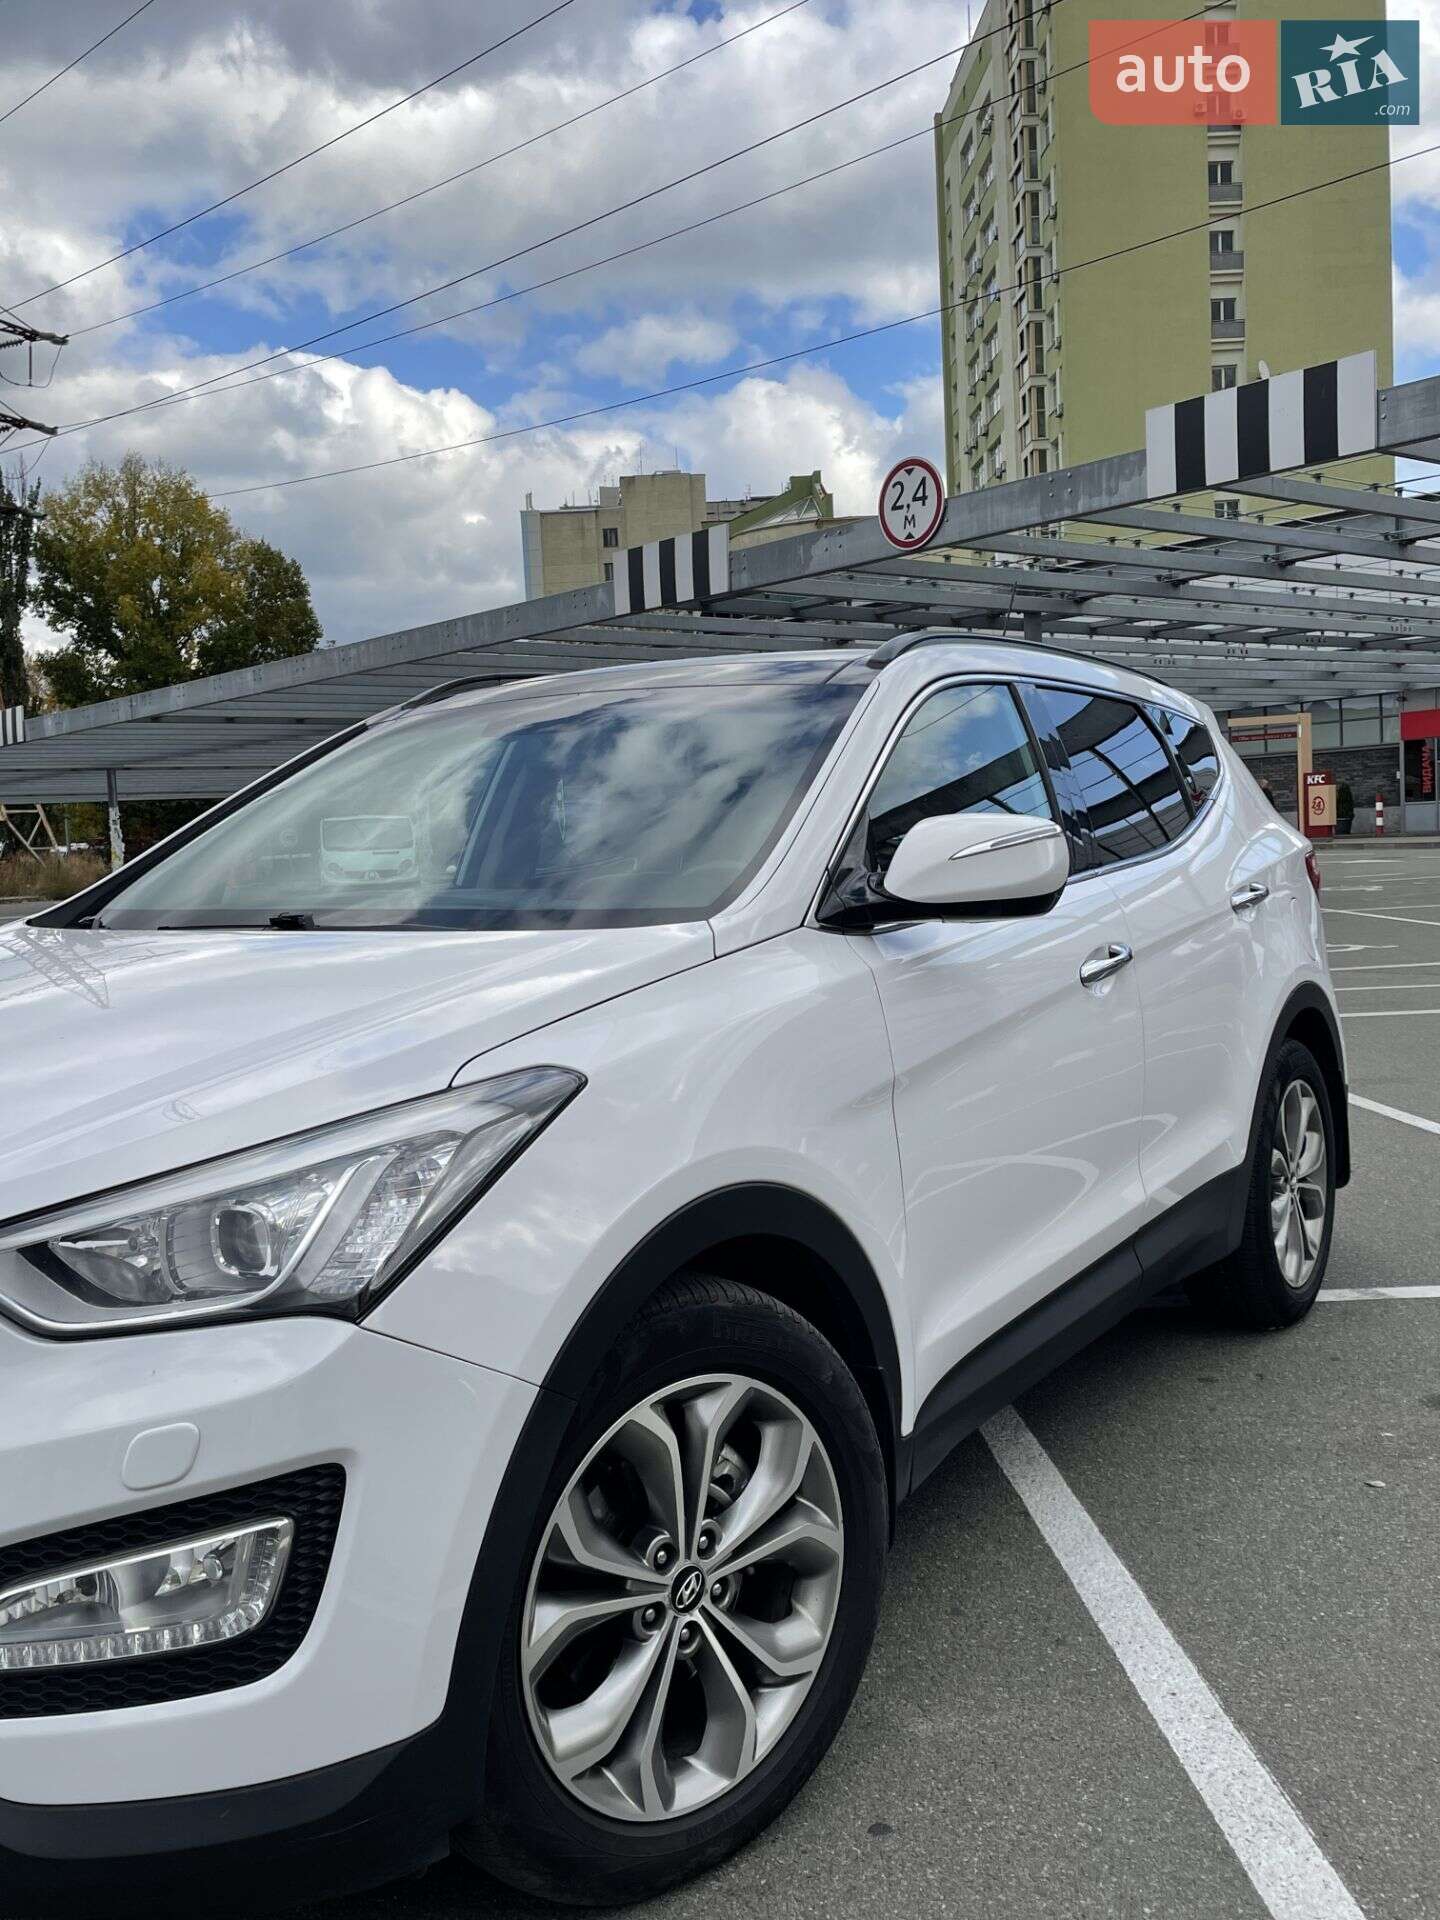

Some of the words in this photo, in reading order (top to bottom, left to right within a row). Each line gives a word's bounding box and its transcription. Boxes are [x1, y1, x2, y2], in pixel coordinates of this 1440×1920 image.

[891, 476, 929, 514] 2,4
[1306, 773, 1326, 785] KFC
[1421, 744, 1433, 793] ВИДАЧА
